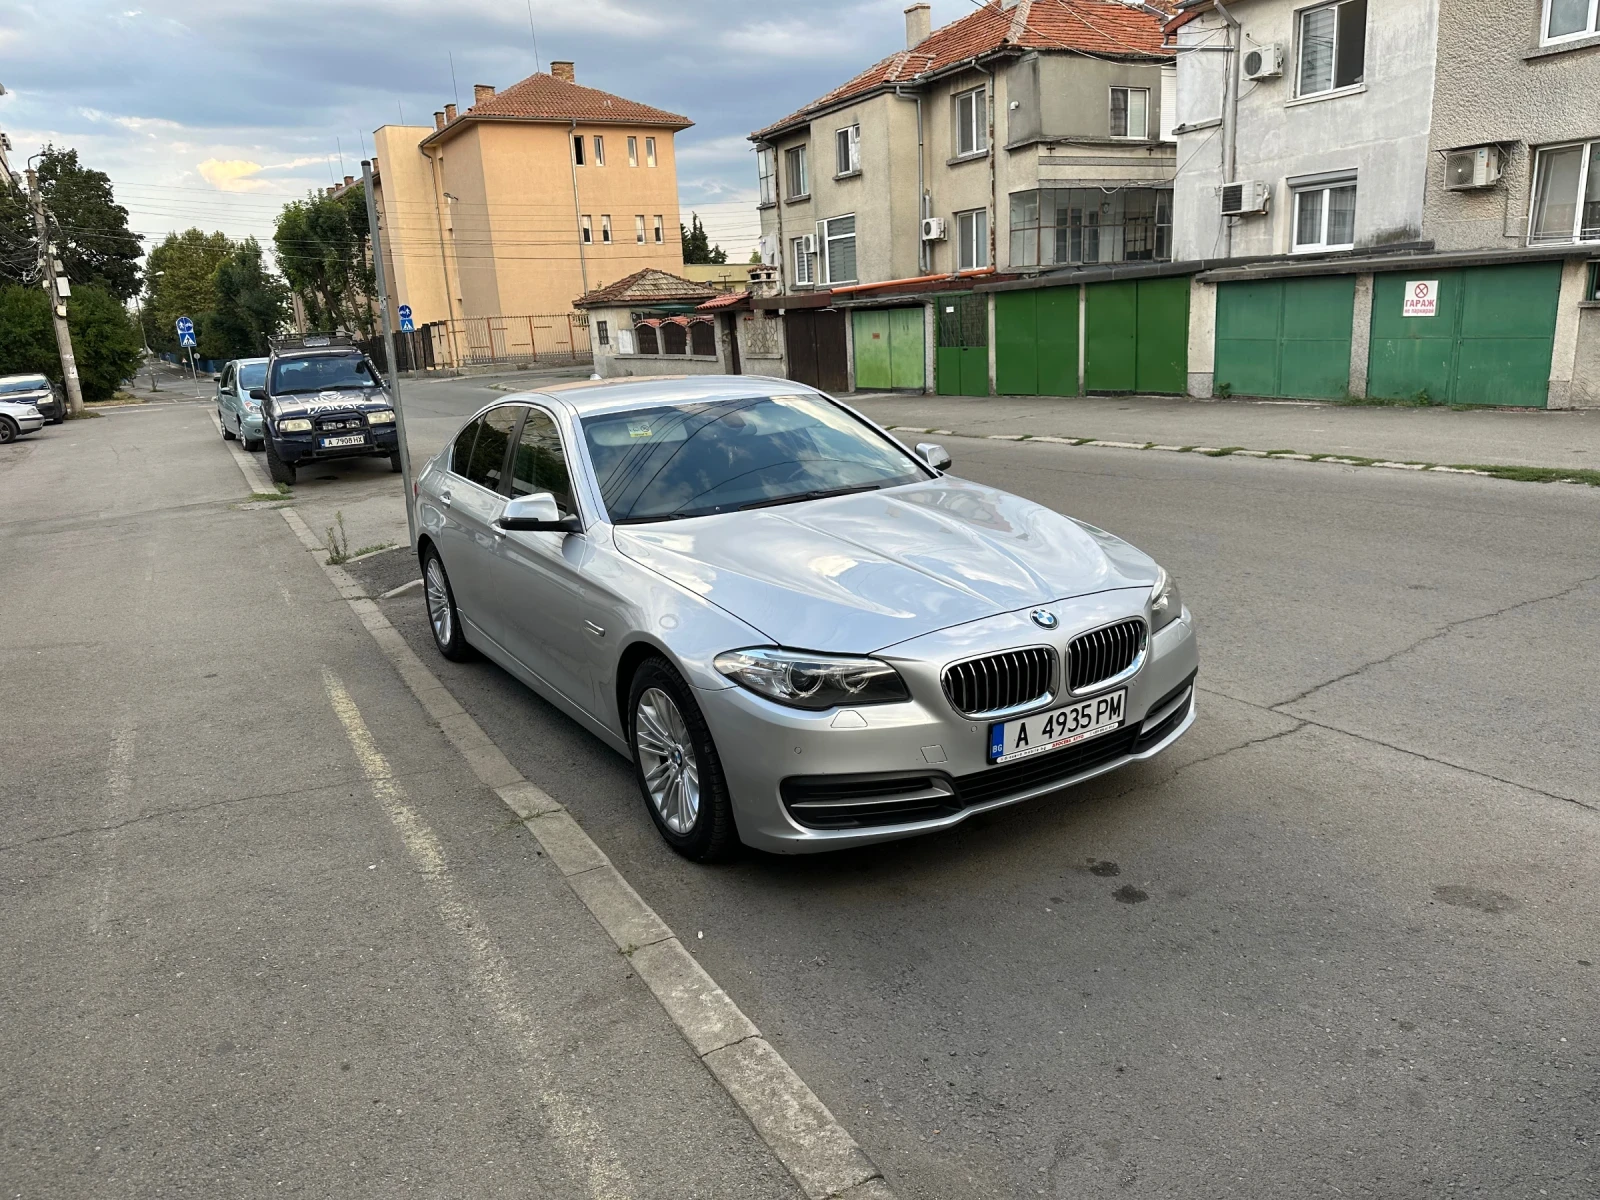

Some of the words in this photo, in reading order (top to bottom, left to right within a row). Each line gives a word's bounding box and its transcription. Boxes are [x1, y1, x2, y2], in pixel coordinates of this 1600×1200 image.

[1405, 300, 1435, 308] ГАРАЖ
[1015, 721, 1029, 749] A
[1041, 703, 1092, 740] 4935
[1095, 693, 1123, 725] PM
[992, 743, 1003, 754] BG
